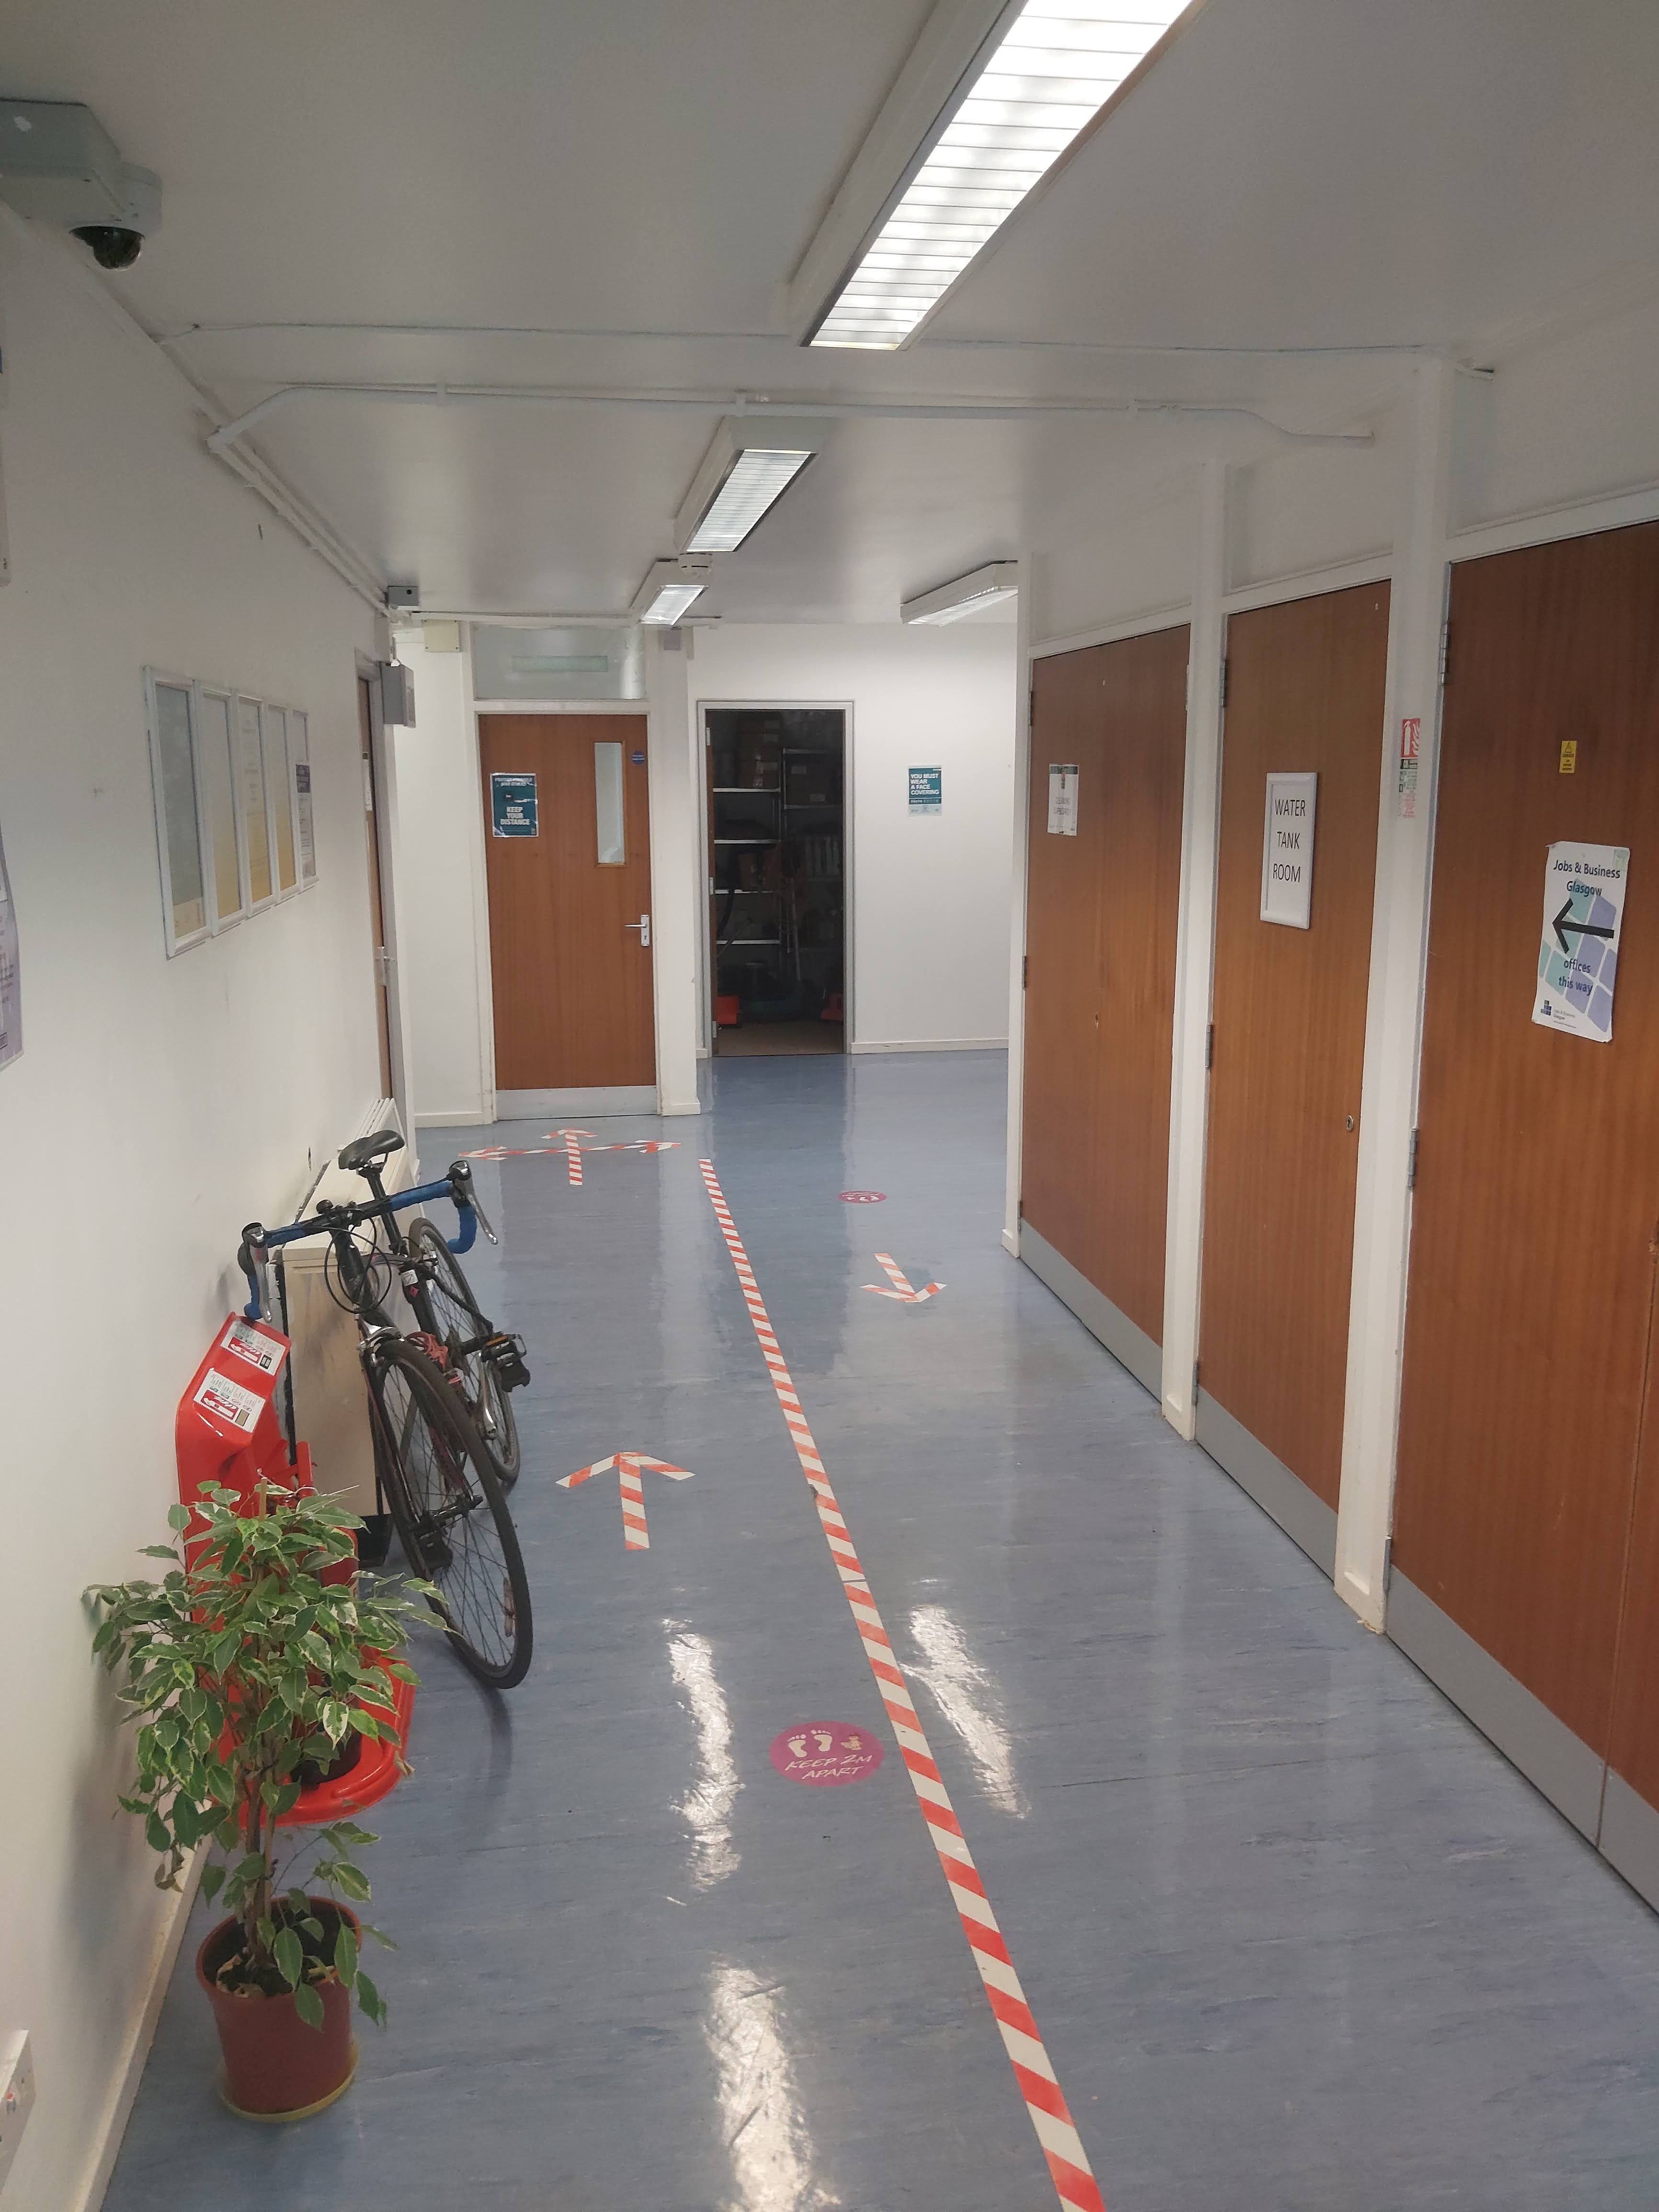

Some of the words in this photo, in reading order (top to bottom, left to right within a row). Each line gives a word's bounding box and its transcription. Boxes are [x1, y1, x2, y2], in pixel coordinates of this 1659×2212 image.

[1274, 799, 1306, 817] WATER
[1277, 831, 1300, 849] TANK
[1273, 863, 1301, 883] ROOM
[1553, 860, 1572, 872] Jobs
[1574, 862, 1581, 874] &
[1584, 863, 1621, 878] Business
[1567, 880, 1602, 897] Glasgow
[1564, 958, 1591, 973] offices
[1558, 976, 1574, 989] this
[1576, 981, 1593, 996] way
[784, 1757, 838, 1771] KEEP
[840, 1754, 873, 1765] 2M
[801, 1766, 864, 1779] APART
